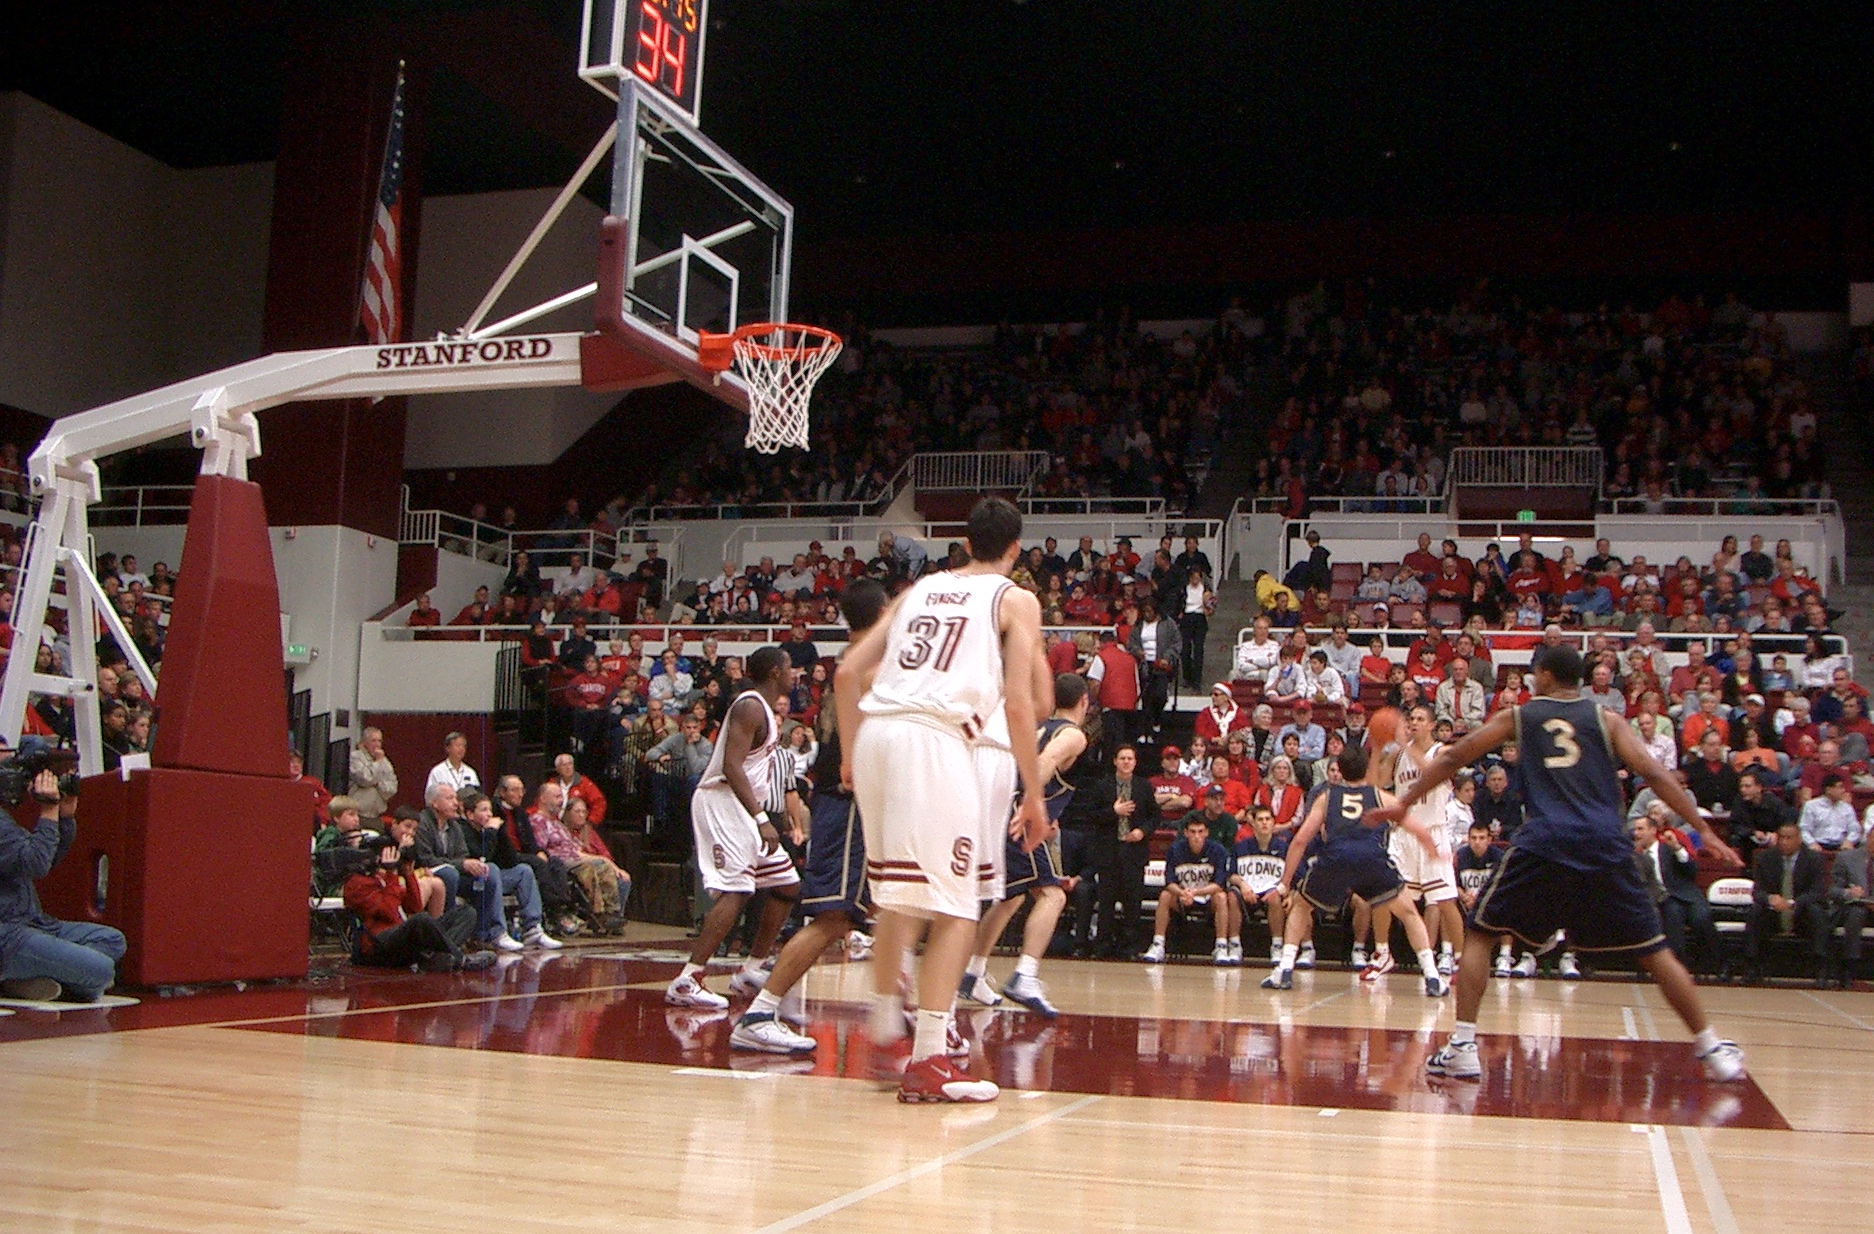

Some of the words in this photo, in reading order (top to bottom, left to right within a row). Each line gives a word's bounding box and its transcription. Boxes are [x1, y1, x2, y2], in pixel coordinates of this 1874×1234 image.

[636, 0, 686, 97] 34
[376, 338, 553, 370] STANFORD
[898, 615, 970, 673] 31
[1542, 717, 1582, 769] 3
[1340, 792, 1364, 820] 5
[712, 844, 726, 869] S
[950, 835, 975, 877] S
[1239, 862, 1253, 876] UC
[1255, 862, 1283, 878] DAVS
